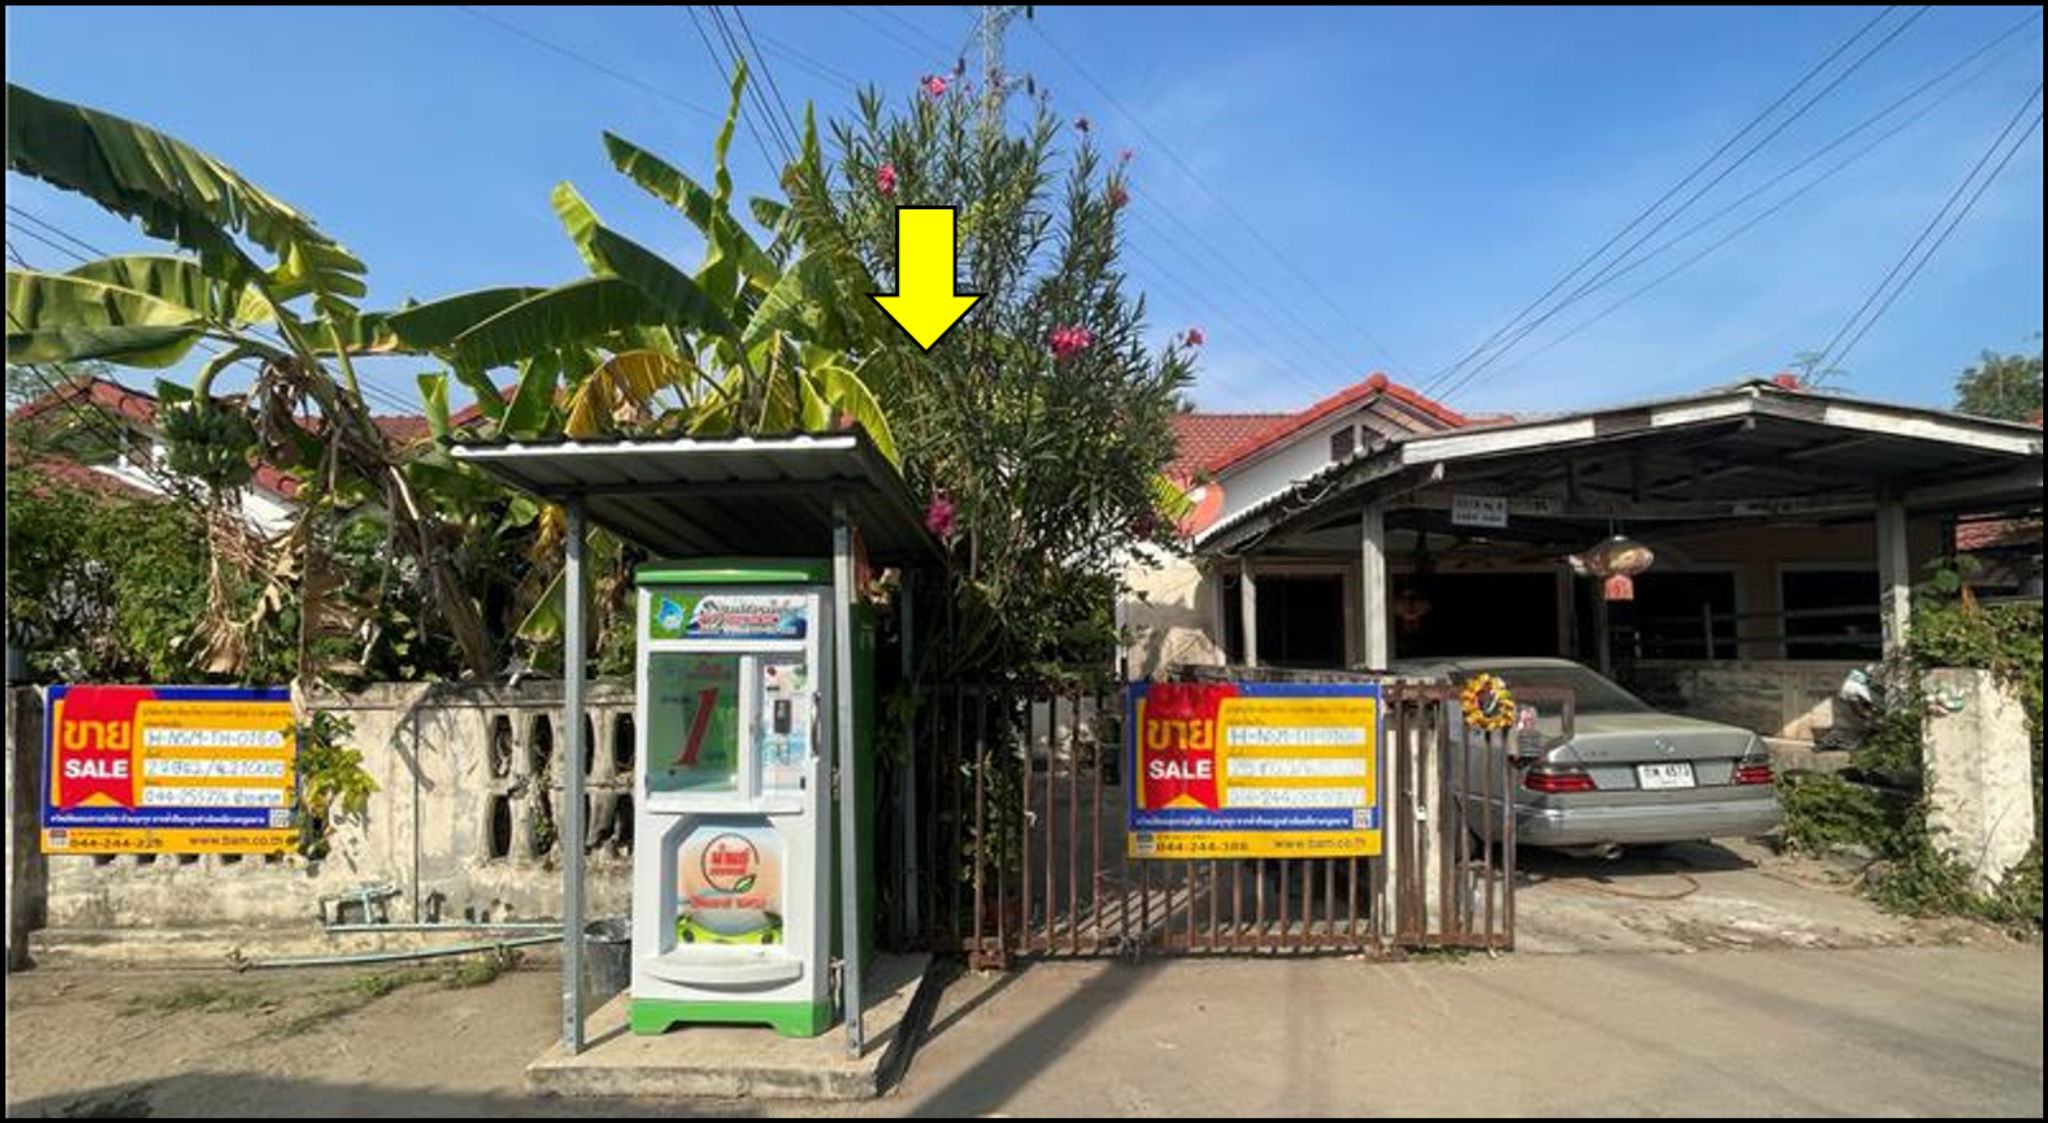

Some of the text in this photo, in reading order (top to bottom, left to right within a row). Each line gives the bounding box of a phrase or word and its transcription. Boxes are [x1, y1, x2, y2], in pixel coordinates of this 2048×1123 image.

[64, 720, 130, 750] ขาย
[1147, 718, 1214, 750] ขาย
[64, 759, 129, 779] SALE
[1149, 760, 1212, 779] SALE
